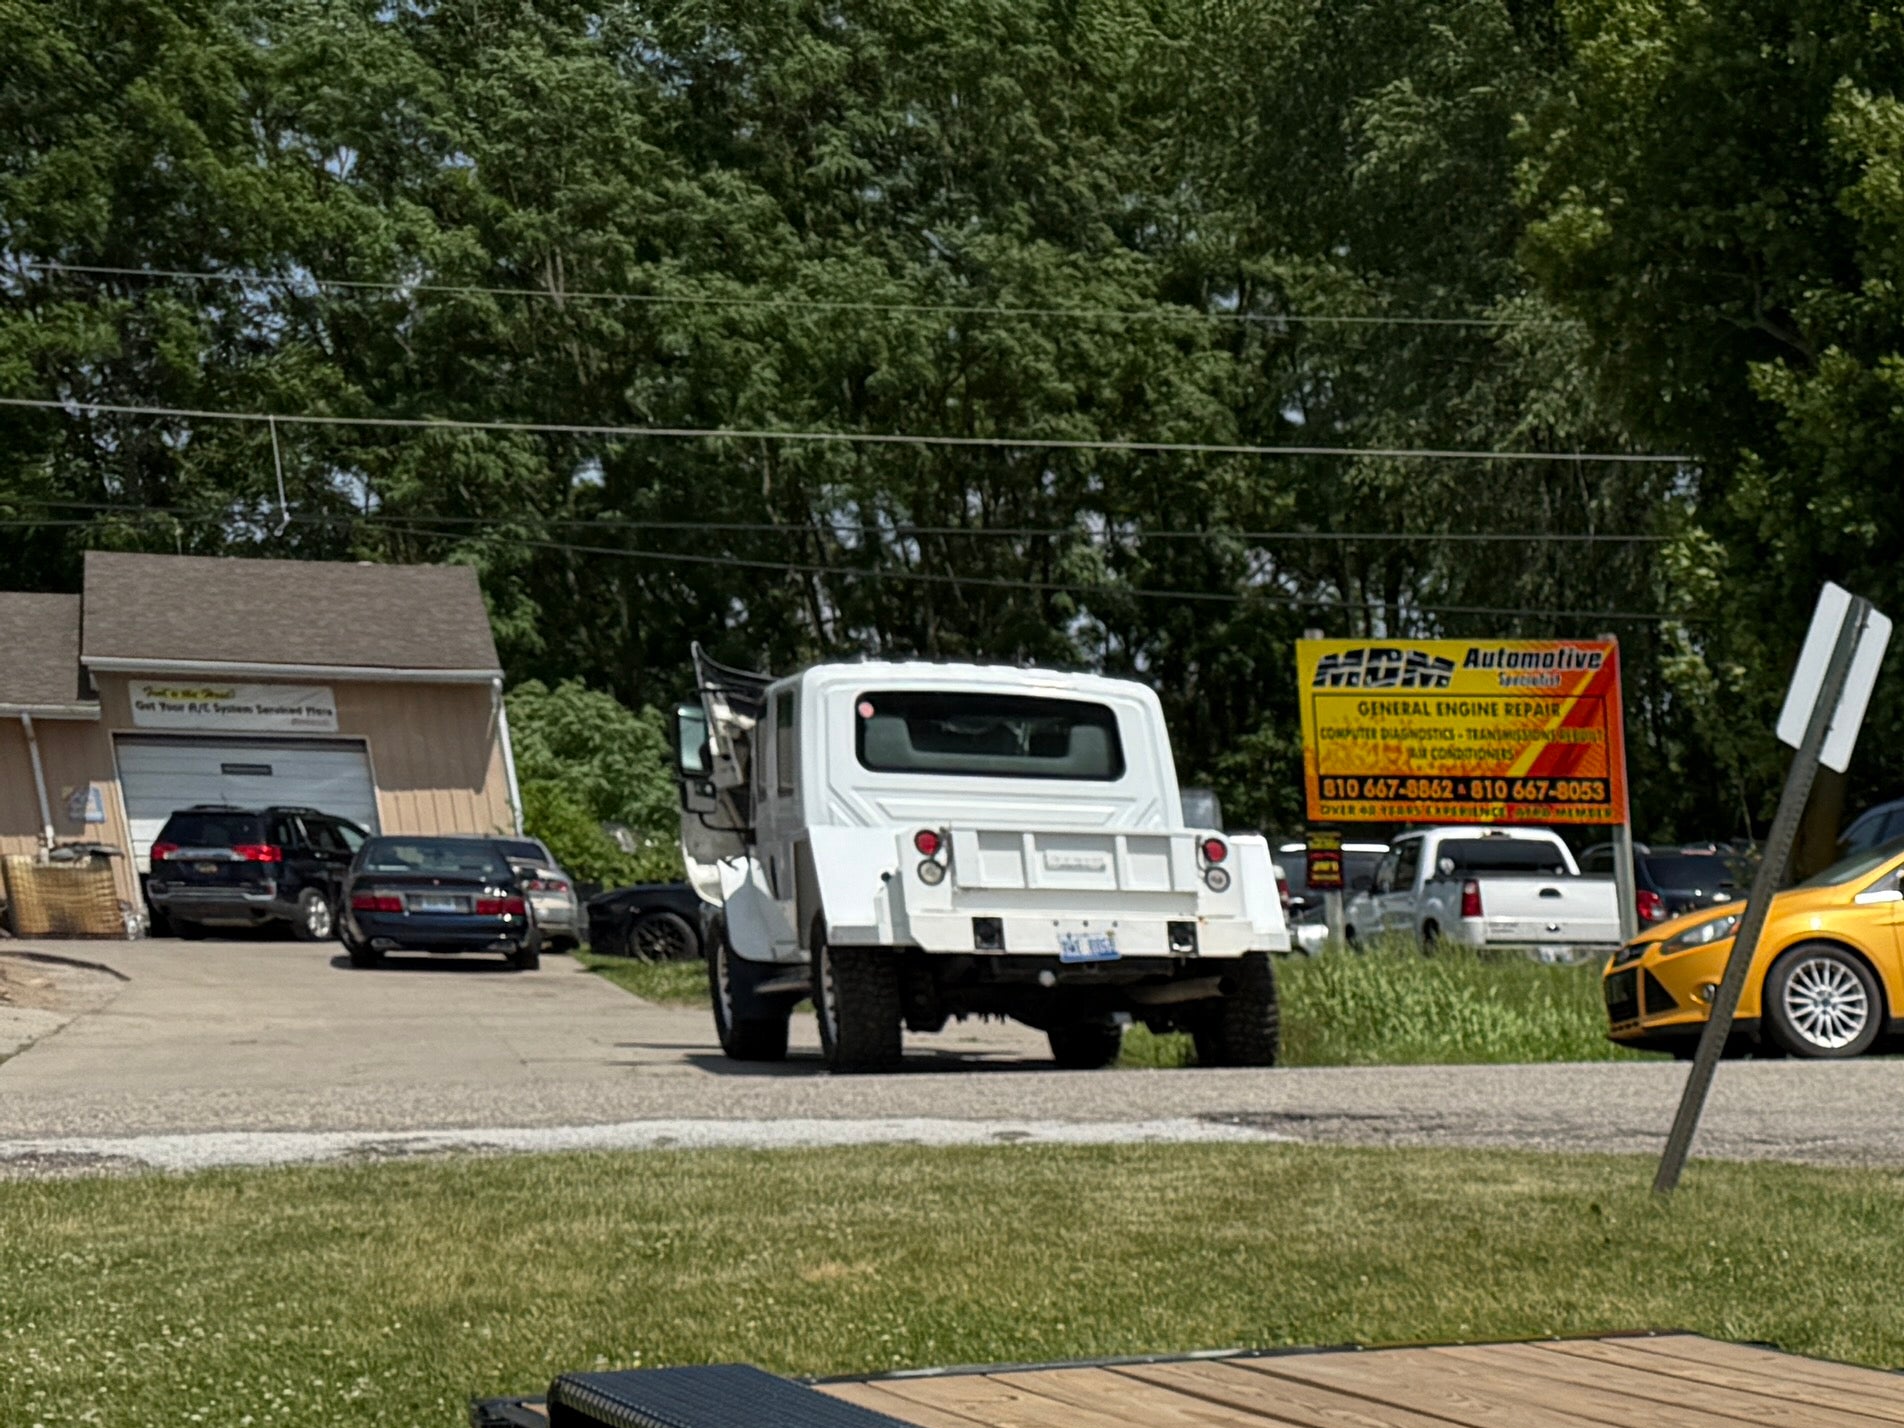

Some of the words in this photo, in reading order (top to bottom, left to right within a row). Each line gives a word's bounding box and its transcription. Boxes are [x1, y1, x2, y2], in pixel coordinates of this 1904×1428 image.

[1463, 647, 1602, 670] Automotive
[1358, 701, 1431, 718] GENERAL
[1436, 701, 1498, 718] ENGINE
[1504, 702, 1561, 718] REPAIR
[1320, 727, 1377, 741] COMPUTER
[1381, 727, 1455, 741] DIAGNOSTICS
[1466, 728, 1557, 743] TRANSMISSIONS
[1430, 748, 1514, 762] CONDITIONERS
[1323, 778, 1359, 798] 810
[1363, 778, 1454, 799] 667-8862
[1470, 779, 1508, 799] 810
[1513, 780, 1605, 800] 667-8053
